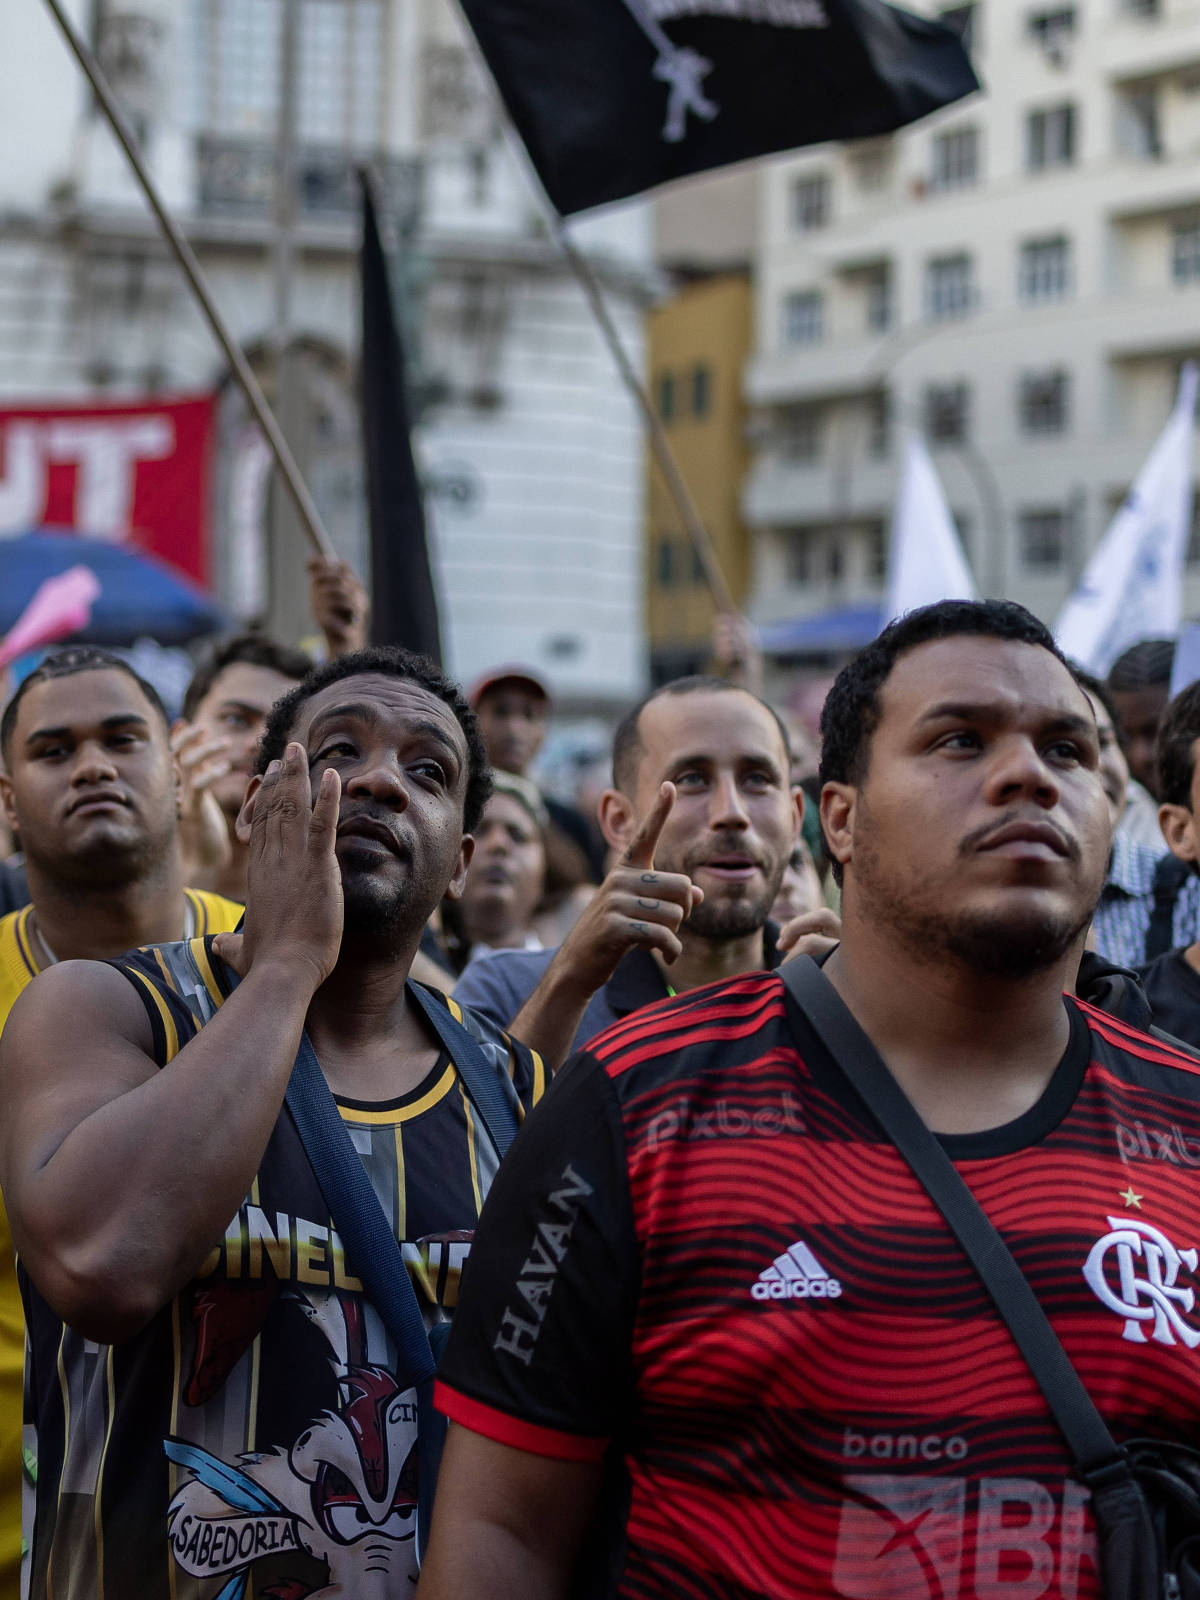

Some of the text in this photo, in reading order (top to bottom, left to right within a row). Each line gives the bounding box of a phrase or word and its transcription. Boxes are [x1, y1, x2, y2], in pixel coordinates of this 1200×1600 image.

[648, 1091, 807, 1153] pixbet
[493, 1163, 594, 1366] HAVAN
[751, 1278, 842, 1300] adidas
[842, 1429, 968, 1461] banco
[175, 1515, 296, 1568] SABEDORIA
